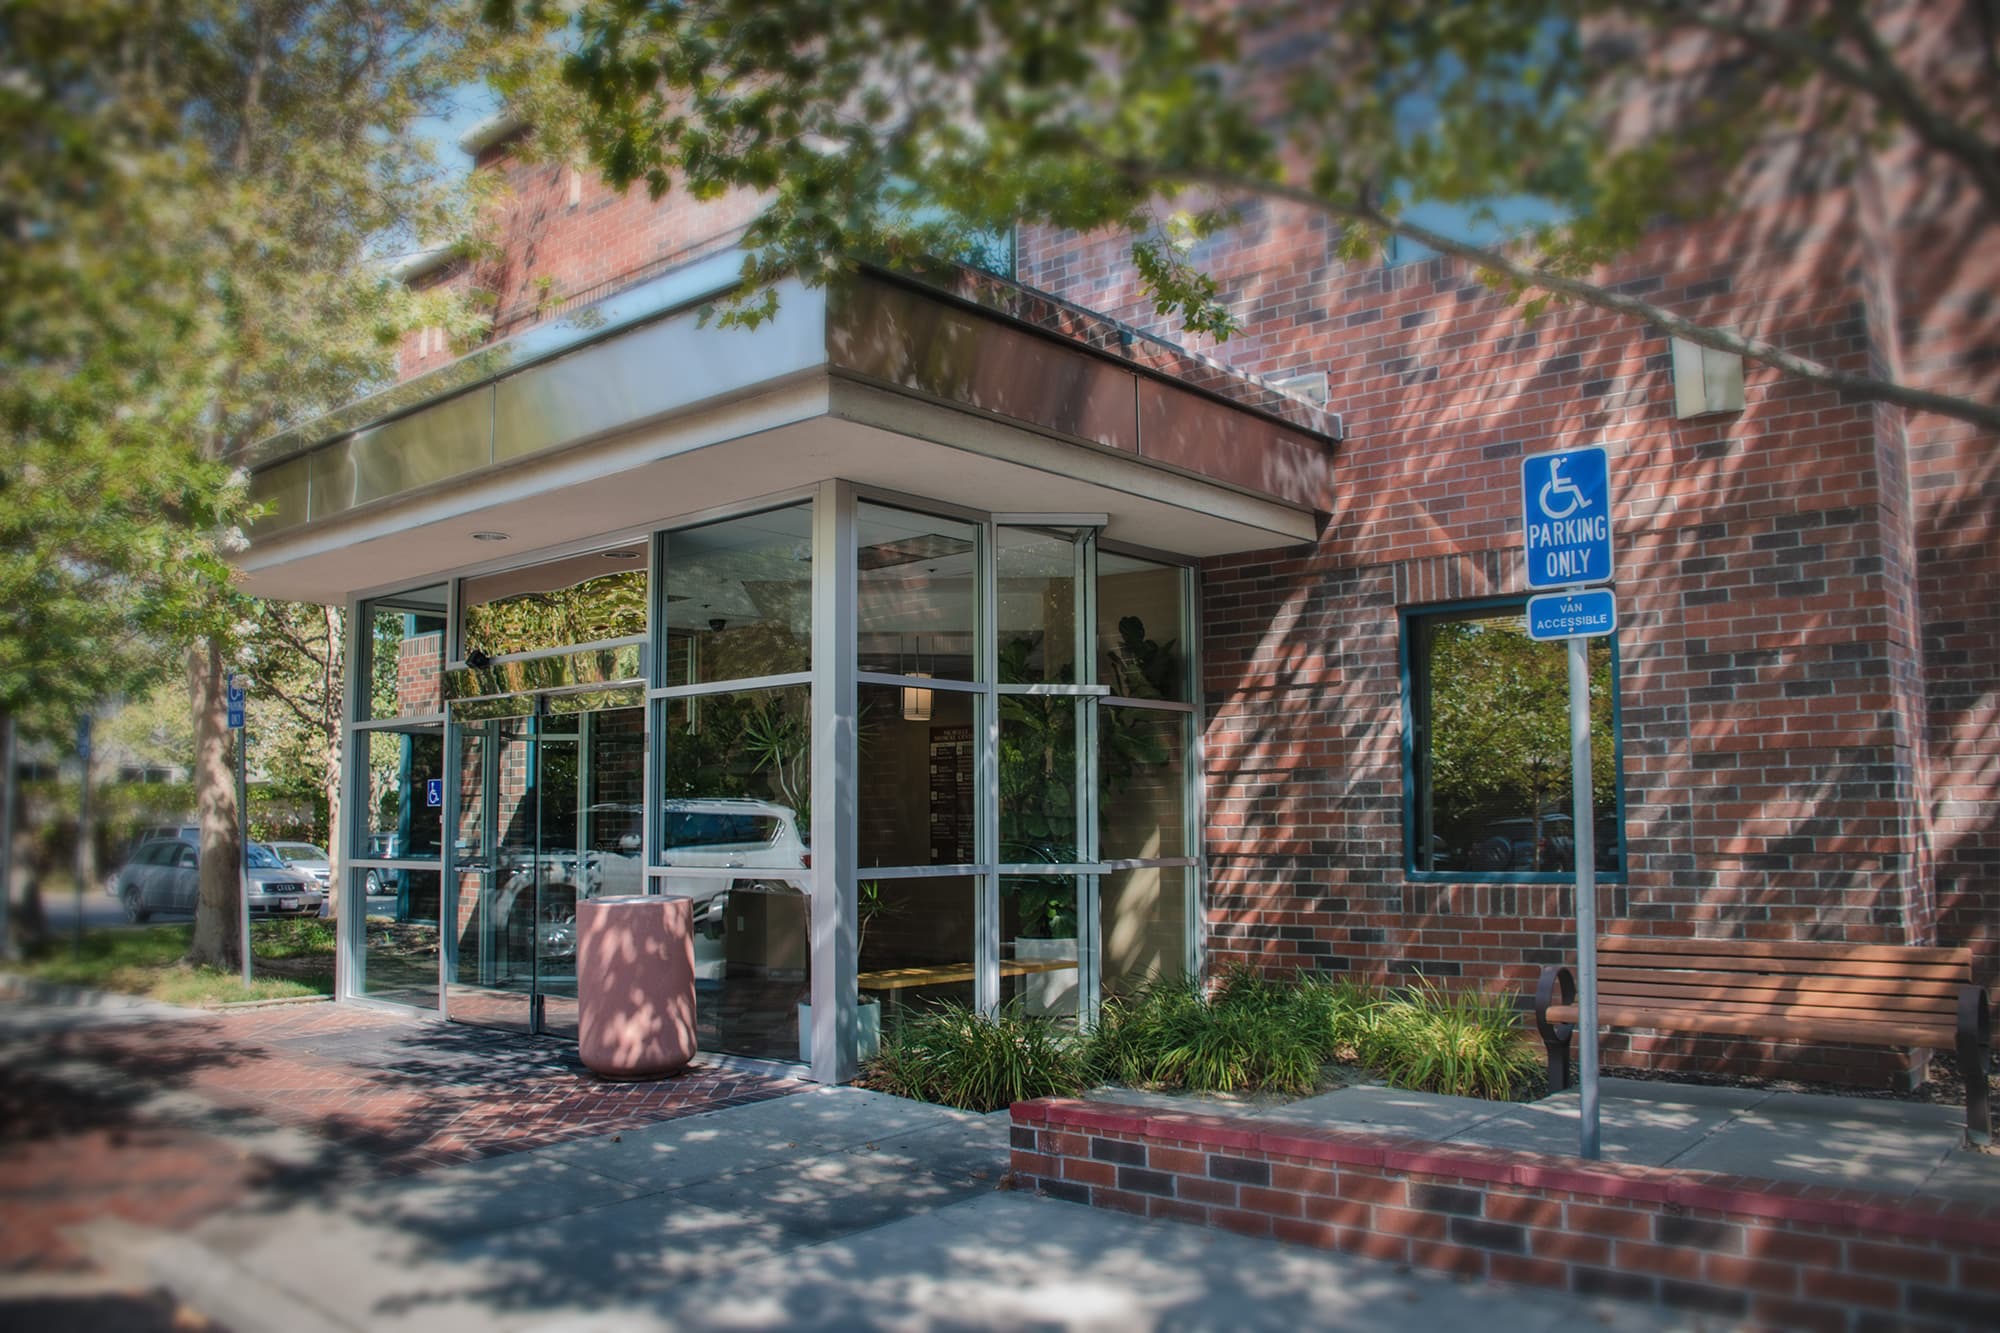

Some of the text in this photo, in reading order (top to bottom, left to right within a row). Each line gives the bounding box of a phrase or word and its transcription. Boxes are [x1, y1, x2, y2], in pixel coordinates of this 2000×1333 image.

[1529, 515, 1606, 549] PARKING
[1546, 548, 1591, 577] ONLY
[1560, 603, 1583, 614] VAN
[1537, 614, 1607, 630] ACCESSIBLE
